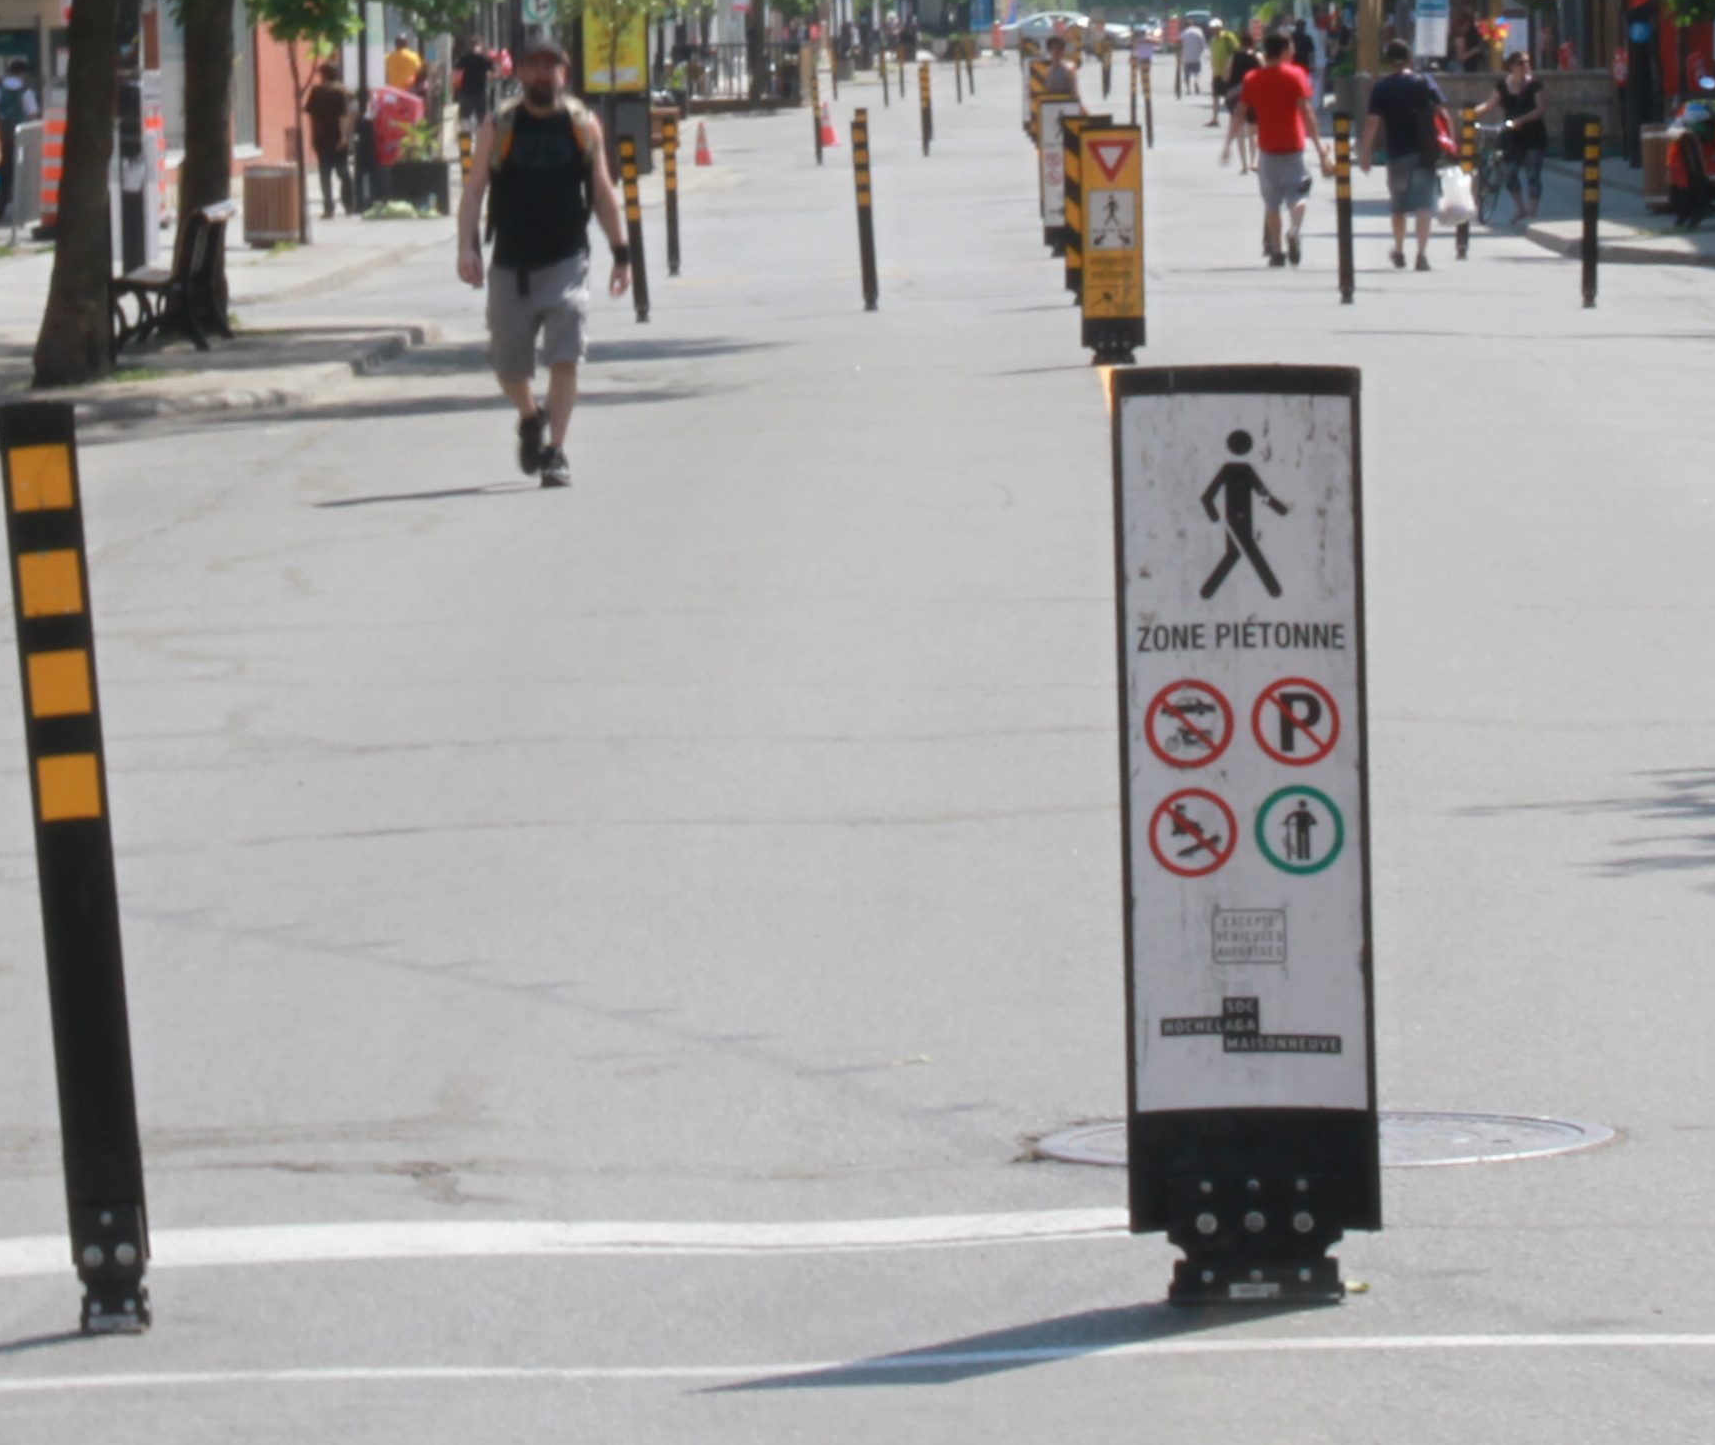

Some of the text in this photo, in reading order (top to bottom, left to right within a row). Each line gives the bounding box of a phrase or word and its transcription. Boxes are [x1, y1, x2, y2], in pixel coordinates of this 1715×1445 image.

[1137, 617, 1345, 652] ZONE PIÉTONNE
[1225, 1000, 1256, 1014] SDC
[1162, 1017, 1258, 1034] HOCHELAGA
[1225, 1036, 1340, 1052] MAISONNEUVE
